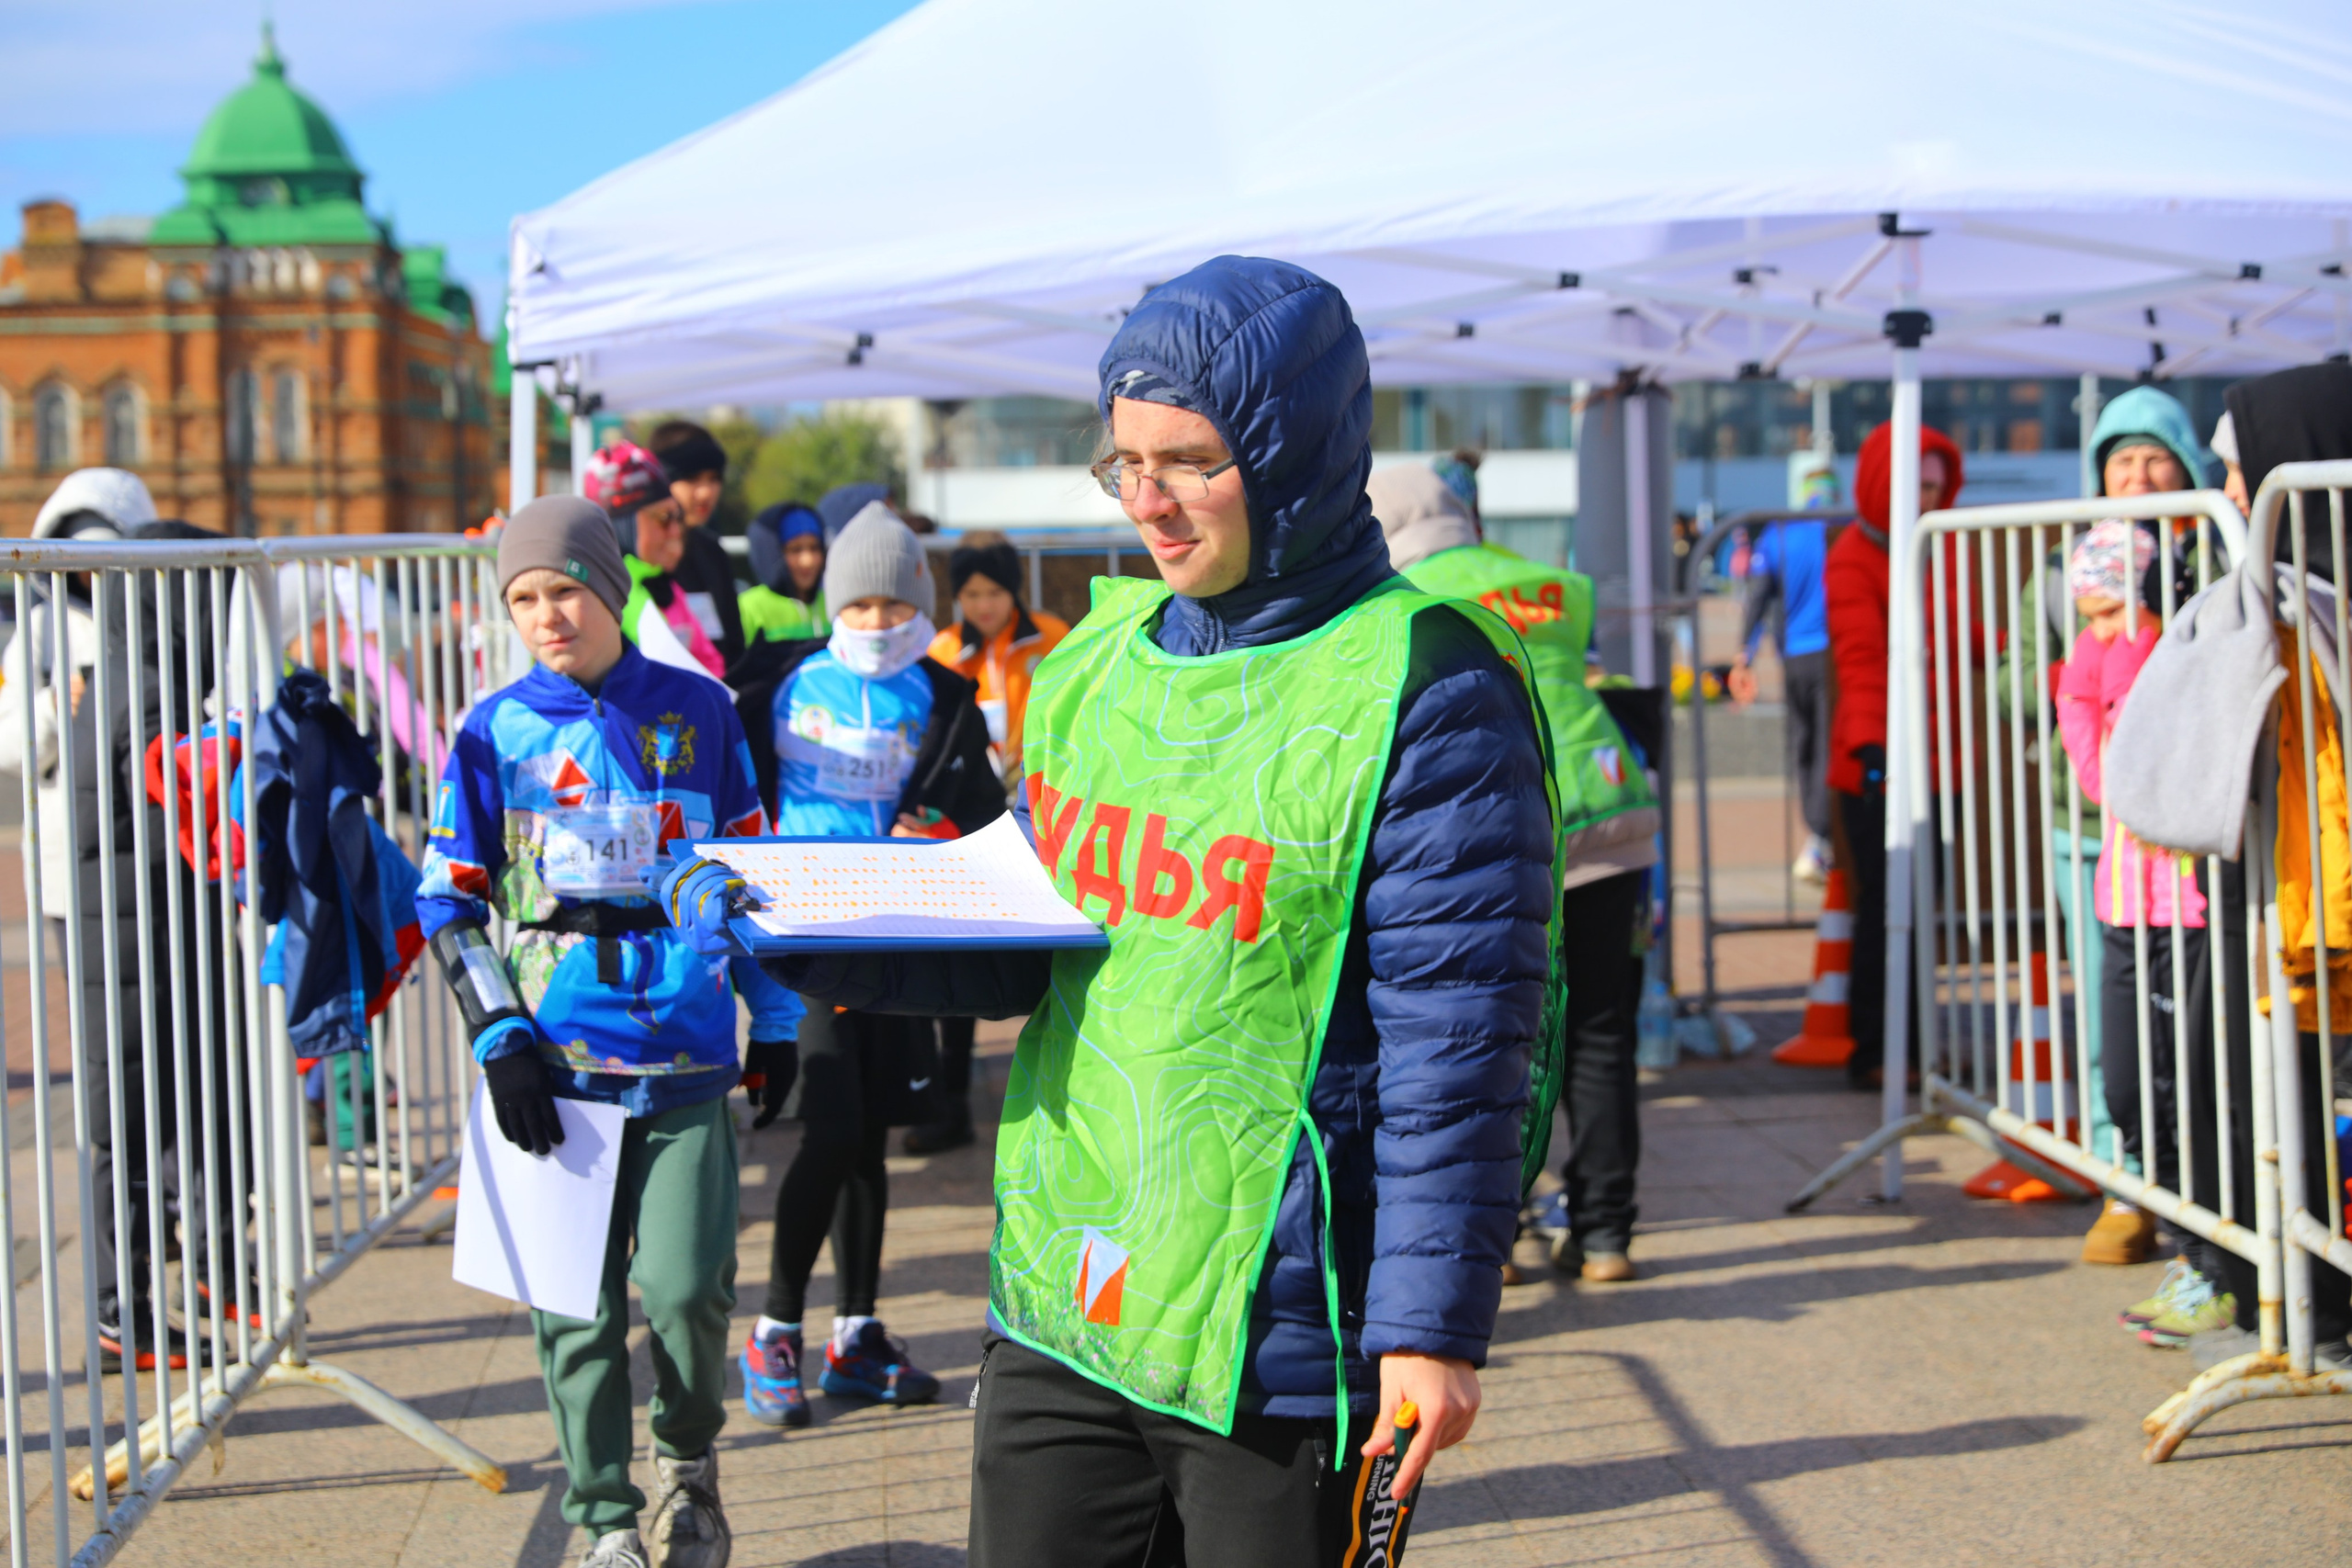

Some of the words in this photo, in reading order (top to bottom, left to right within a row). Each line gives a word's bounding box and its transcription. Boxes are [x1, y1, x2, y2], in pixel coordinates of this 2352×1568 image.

[1478, 582, 1564, 636] ДЬЯ
[849, 758, 885, 778] 251
[585, 838, 628, 862] 141
